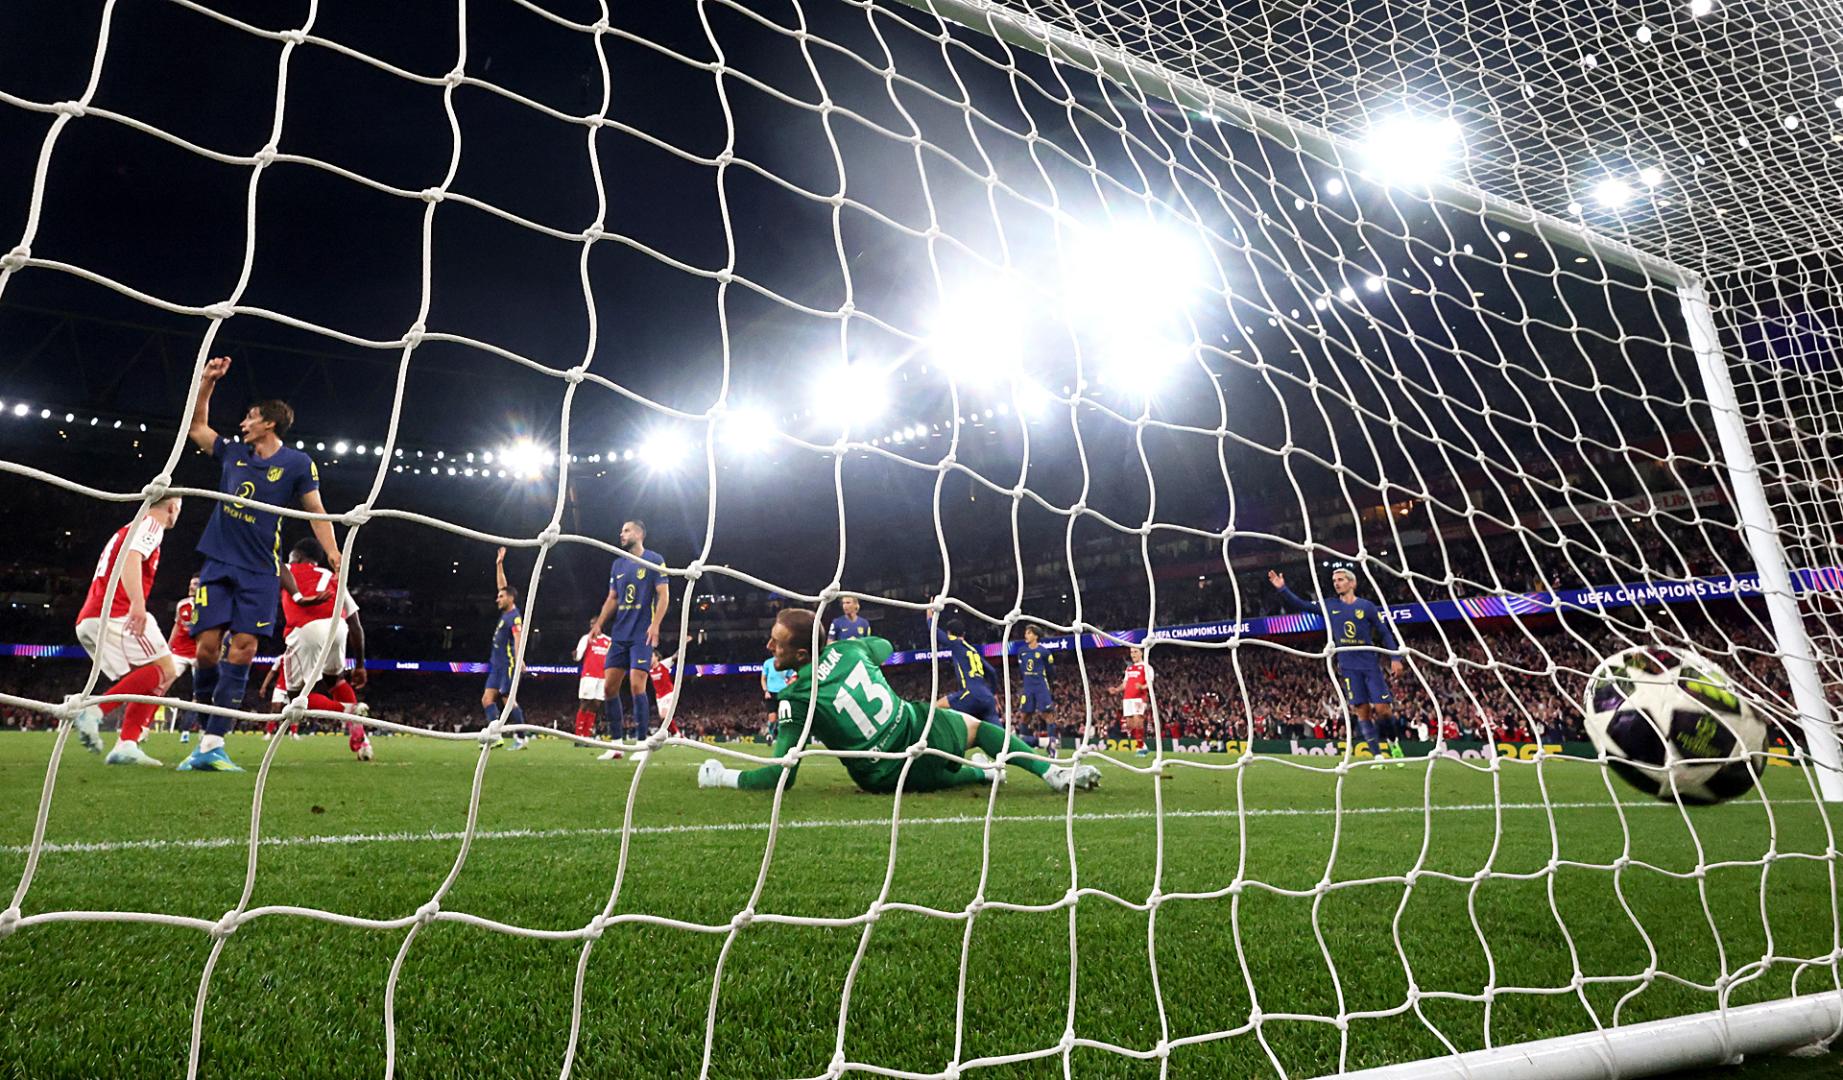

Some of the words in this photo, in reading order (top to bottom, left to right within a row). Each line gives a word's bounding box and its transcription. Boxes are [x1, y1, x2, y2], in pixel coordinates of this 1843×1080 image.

[1663, 491, 1718, 509] Libria
[313, 566, 333, 592] 7
[1577, 590, 1613, 605] UEFA
[1616, 582, 1706, 602] CHAMPIONS
[1709, 578, 1763, 594] LEAGU
[1171, 625, 1217, 639] CHAMPIONS
[1218, 622, 1250, 634] LEAGUE
[833, 660, 894, 741] 13
